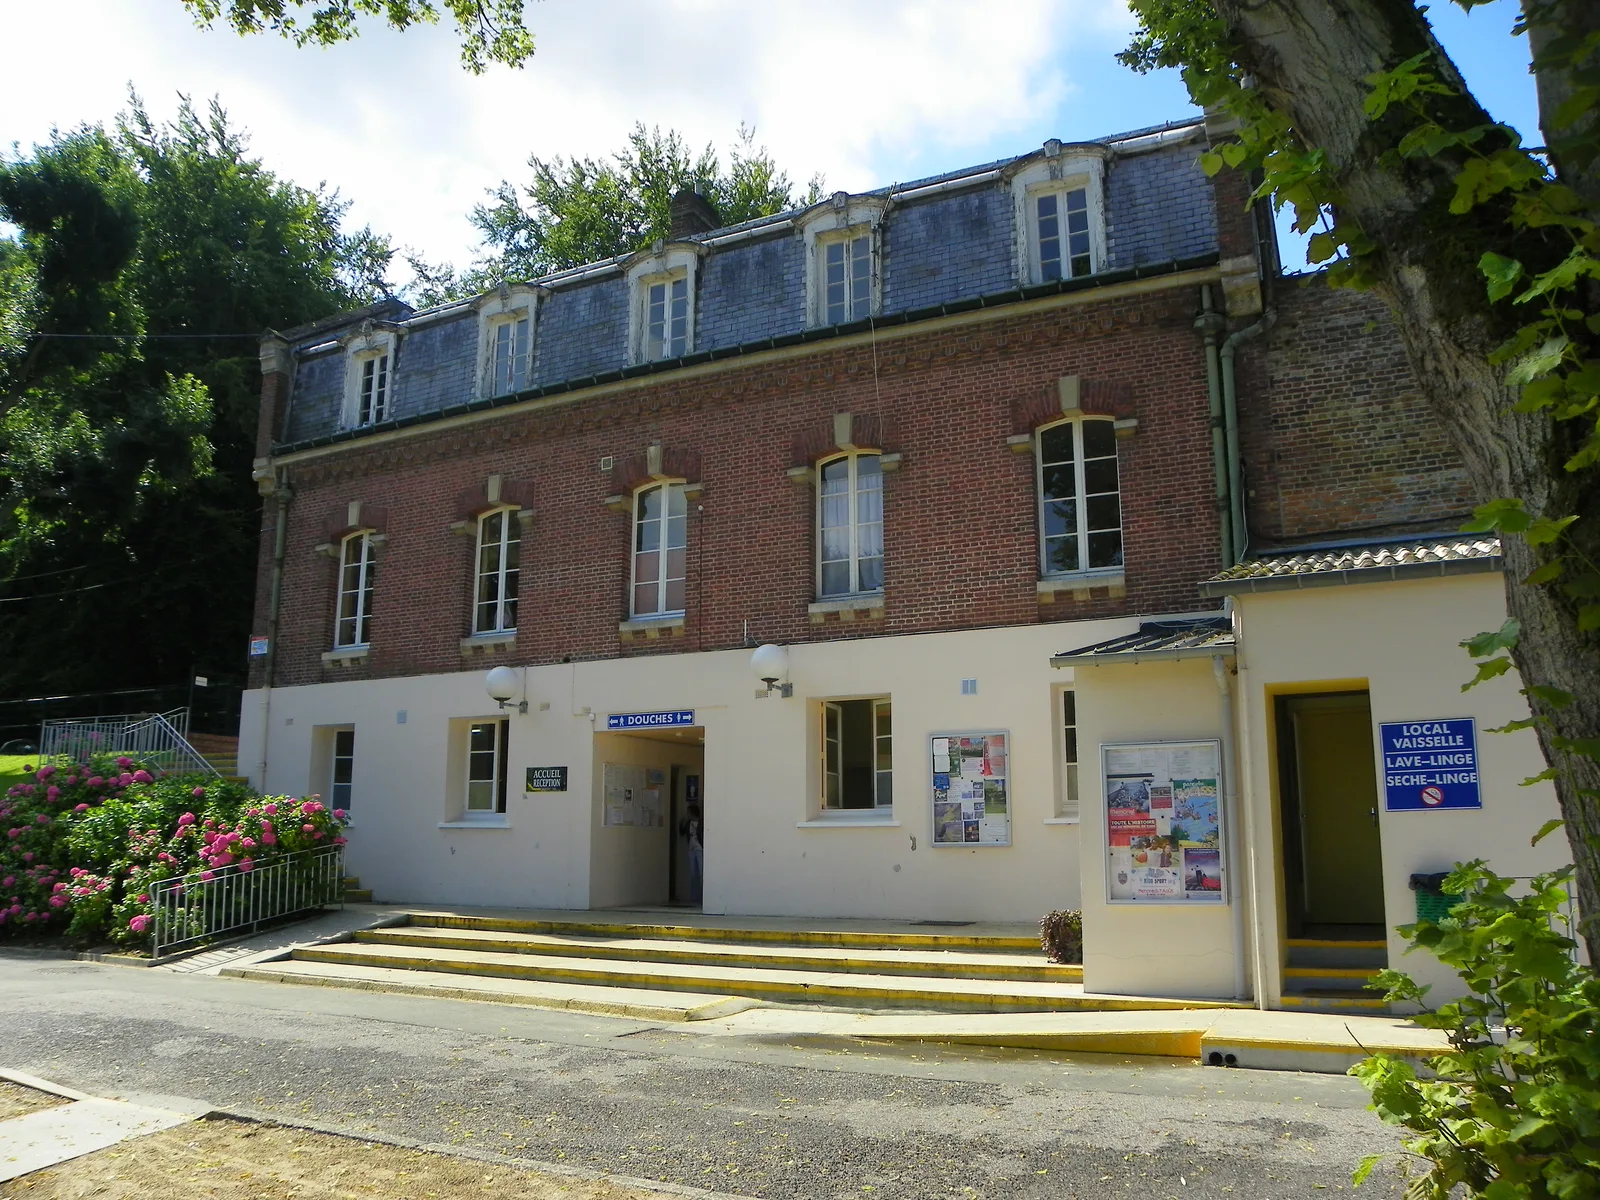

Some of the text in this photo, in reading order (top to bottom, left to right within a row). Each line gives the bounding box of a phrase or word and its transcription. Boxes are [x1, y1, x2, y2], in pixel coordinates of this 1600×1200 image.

[628, 713, 673, 725] DOUCHES
[1403, 724, 1450, 736] LOCAL
[1392, 735, 1464, 748] VAISSELLE
[1387, 754, 1473, 768] LAVE-LINGE
[533, 769, 561, 779] ACCUEIL
[1387, 773, 1477, 787] SECHE-LINGE
[533, 778, 561, 788] RECEPTION
